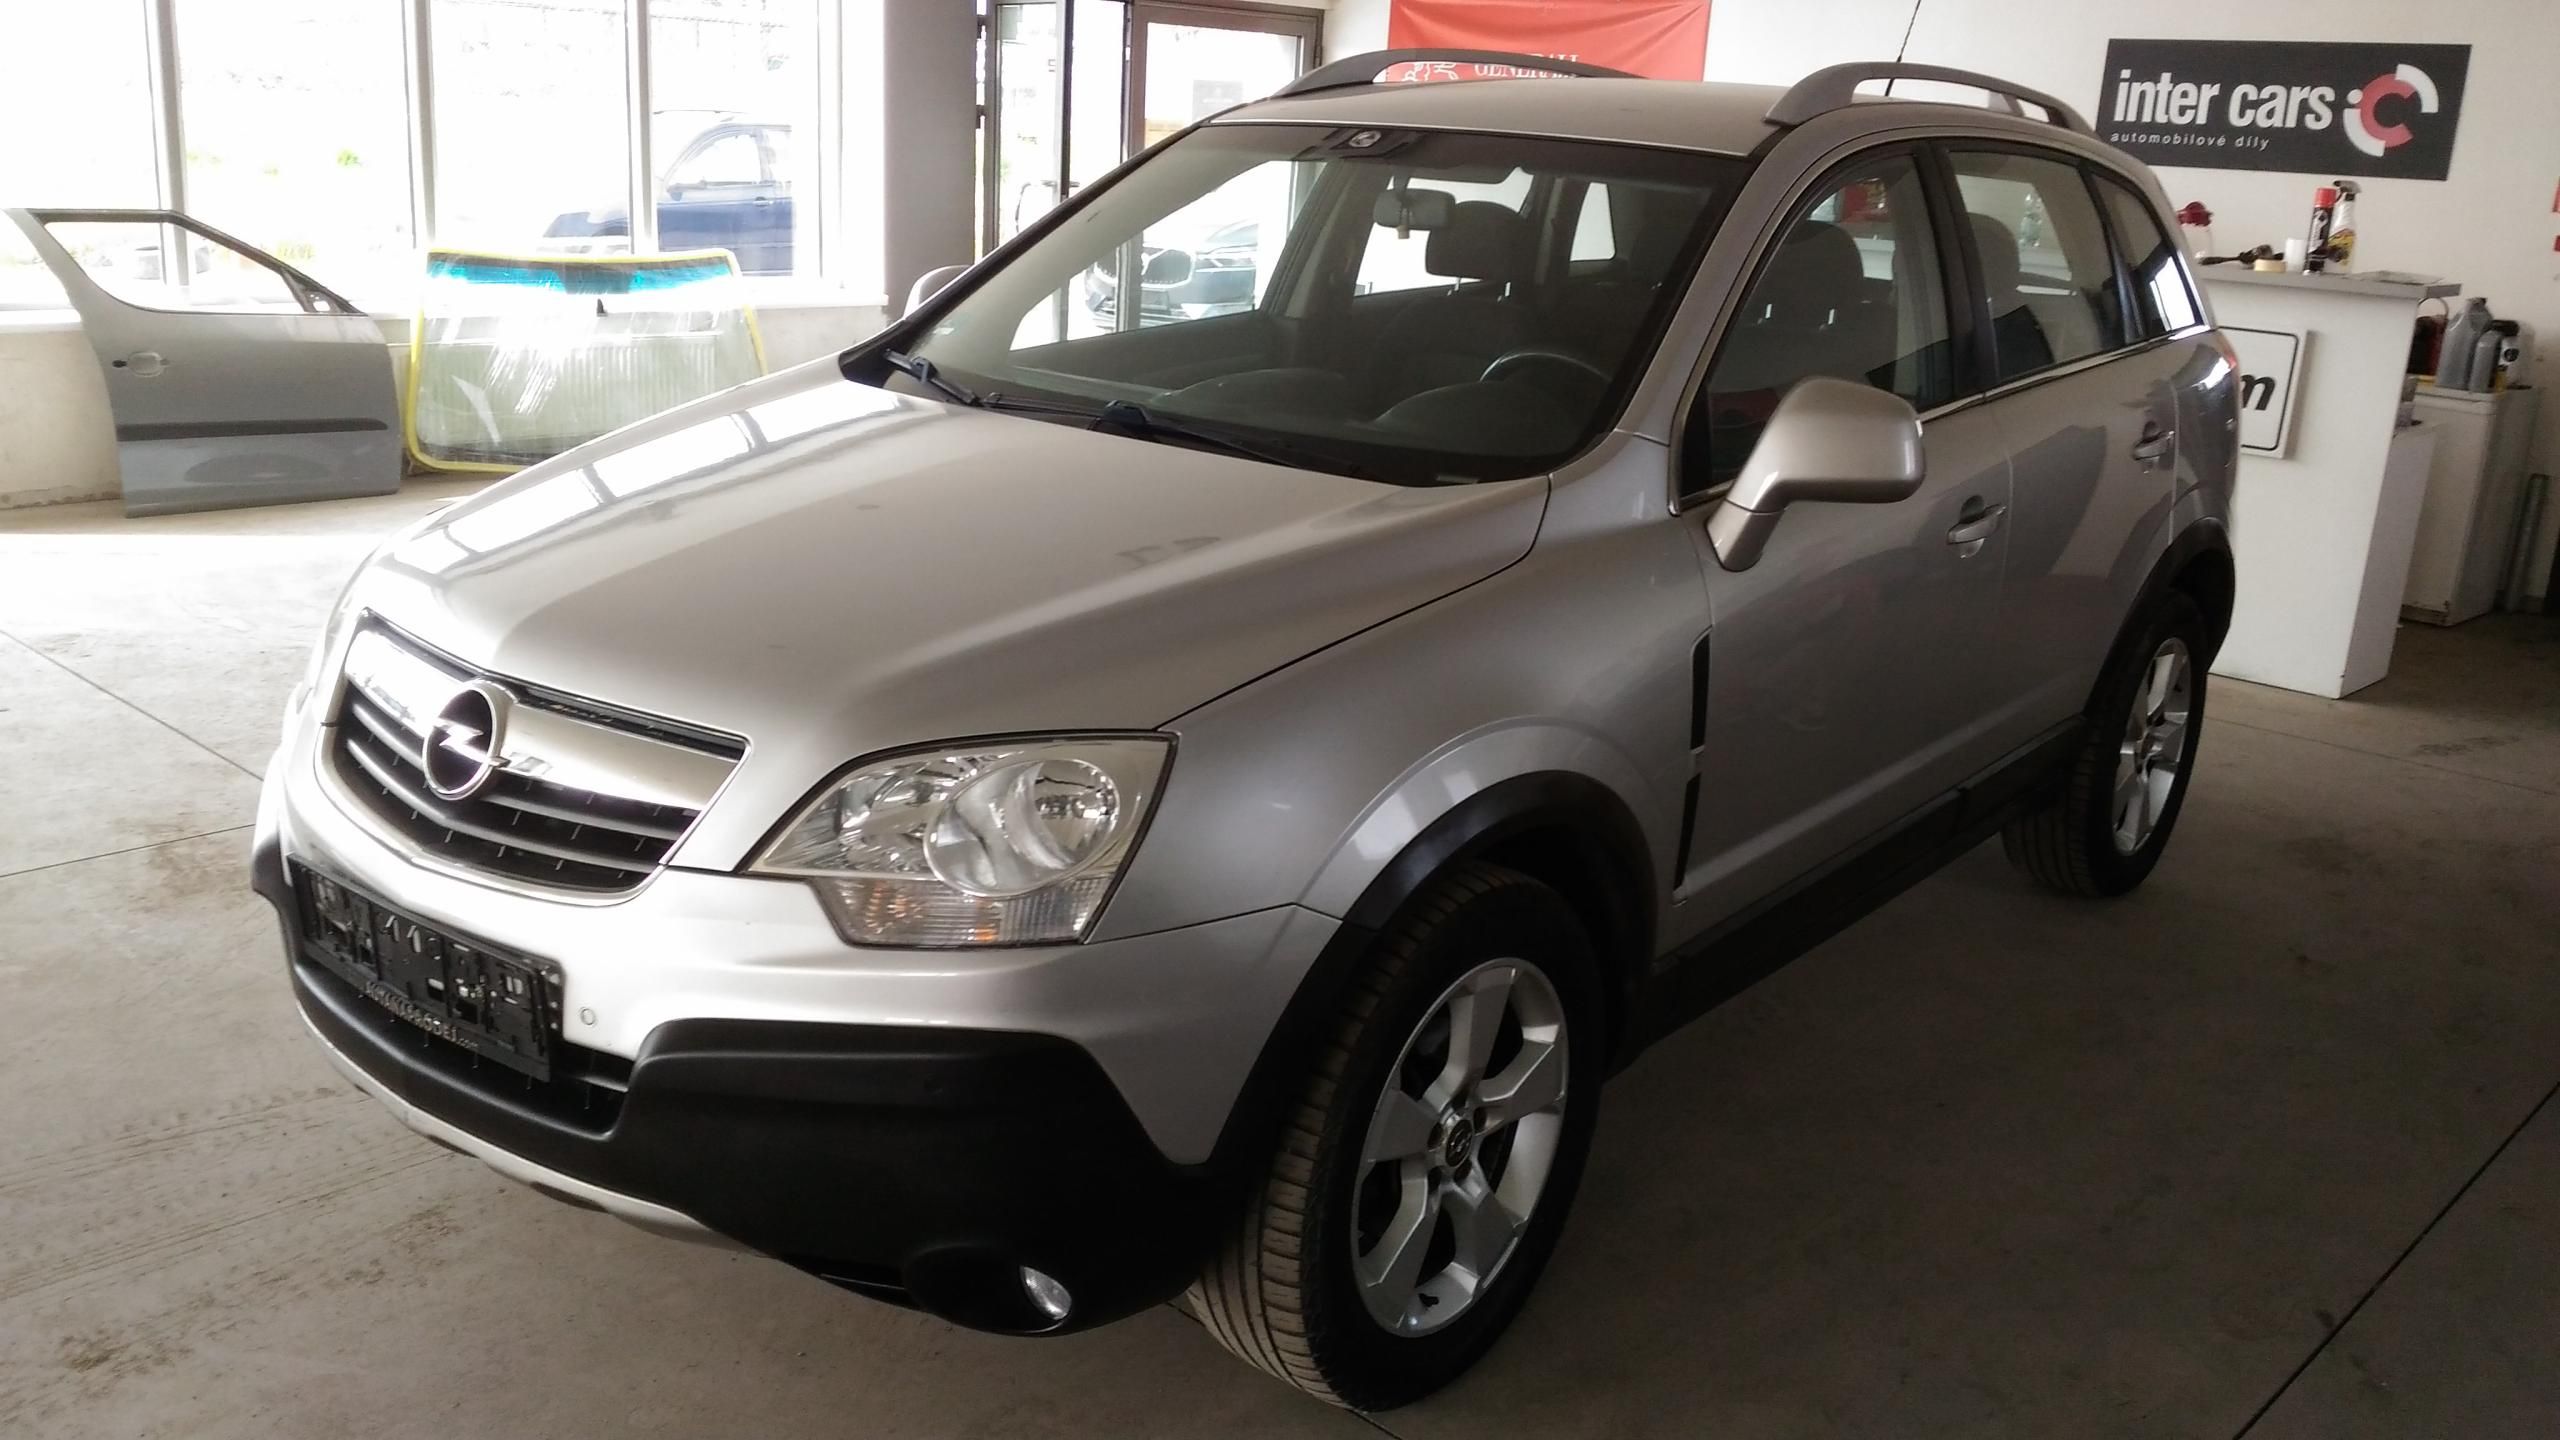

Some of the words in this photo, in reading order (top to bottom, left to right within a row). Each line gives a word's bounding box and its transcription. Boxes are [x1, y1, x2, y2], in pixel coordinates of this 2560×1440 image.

[2113, 68, 2221, 125] inter
[2228, 83, 2336, 131] cars
[2110, 131, 2226, 147] automobilové
[2235, 135, 2269, 151] díly
